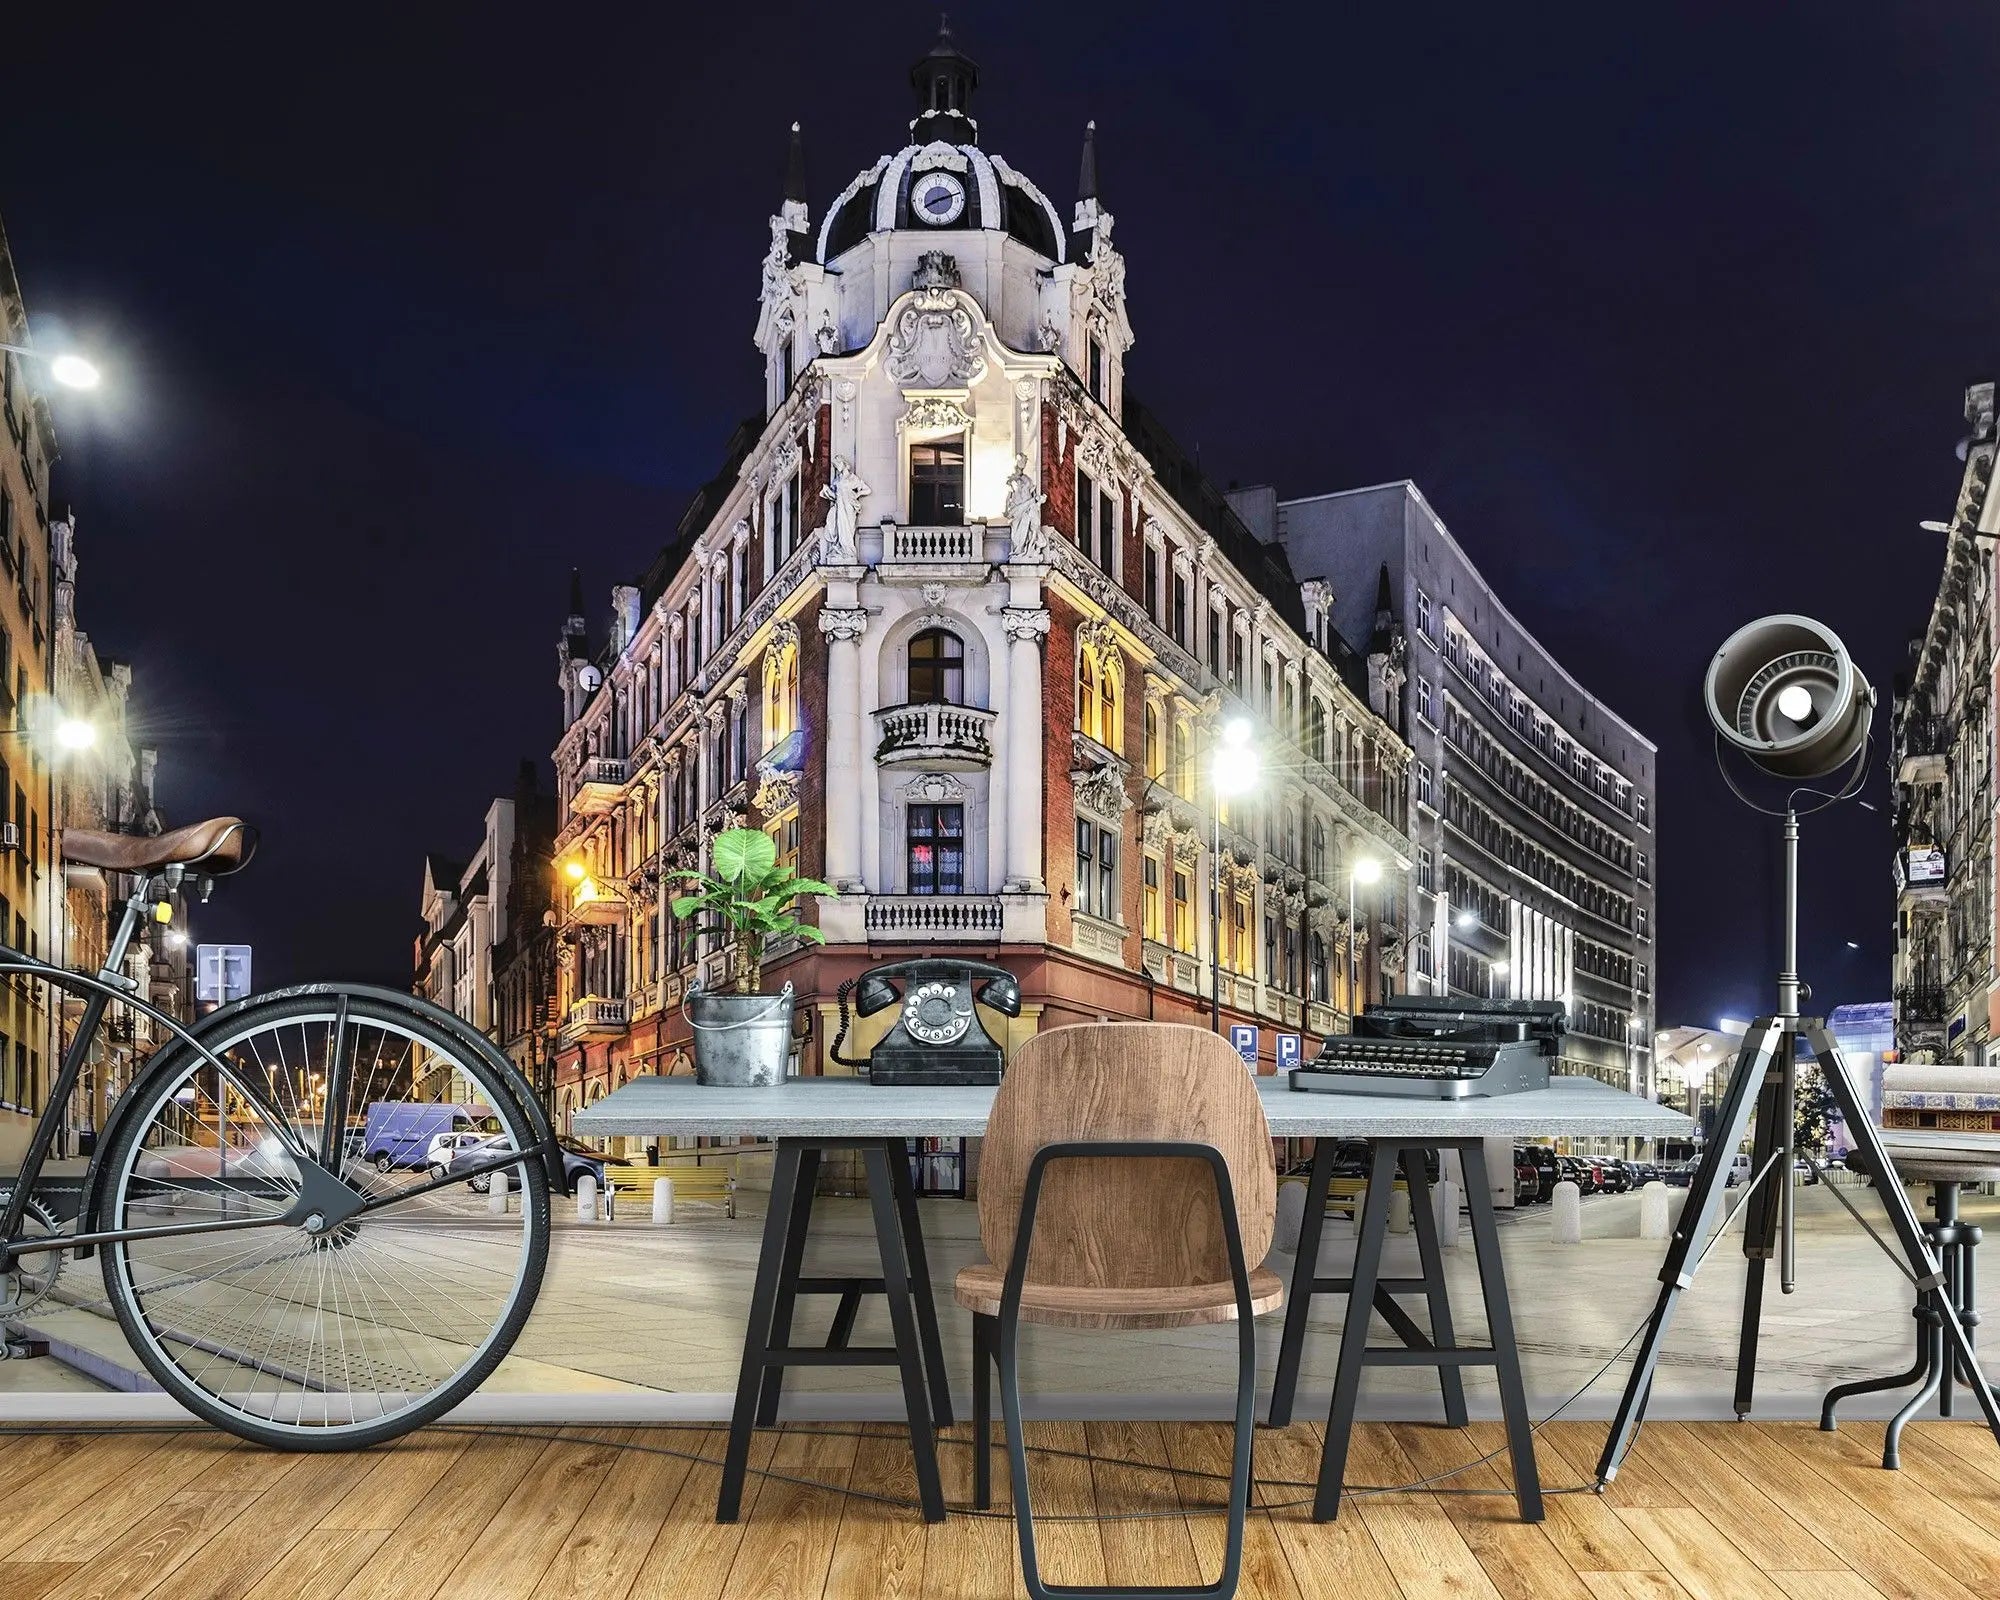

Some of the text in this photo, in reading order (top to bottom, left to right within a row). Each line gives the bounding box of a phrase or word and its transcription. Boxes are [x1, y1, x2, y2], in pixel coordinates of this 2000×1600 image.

[934, 1031, 940, 1039] 8
[1237, 1029, 1252, 1052] P
[1282, 1038, 1296, 1058] P
[1695, 1127, 1701, 1136] P
